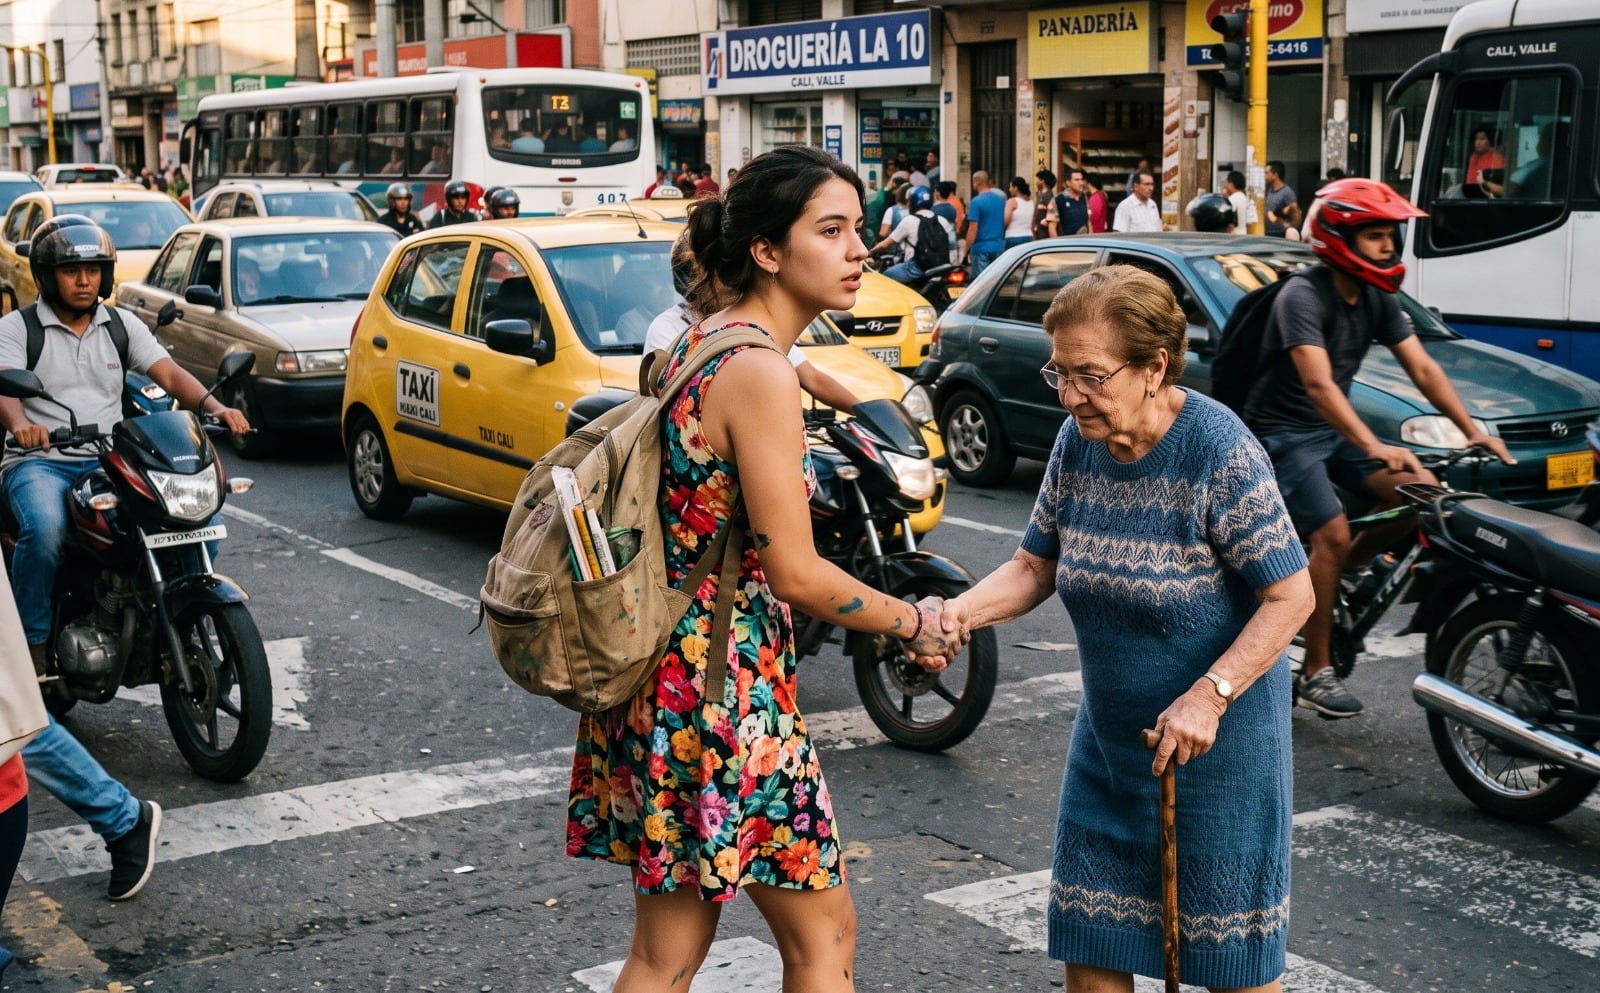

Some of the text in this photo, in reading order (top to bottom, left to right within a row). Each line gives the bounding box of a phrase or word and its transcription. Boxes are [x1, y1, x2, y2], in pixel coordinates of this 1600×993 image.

[1038, 7, 1138, 37] PANADERÍA
[730, 23, 925, 72] DROGUERÍA LA 10
[1486, 42, 1557, 57] CALI, VALLE
[791, 74, 845, 87] CALI, VALLE
[400, 368, 434, 404] TAXÍ
[420, 407, 436, 421] CALI
[478, 425, 514, 449] TAXI CALI
